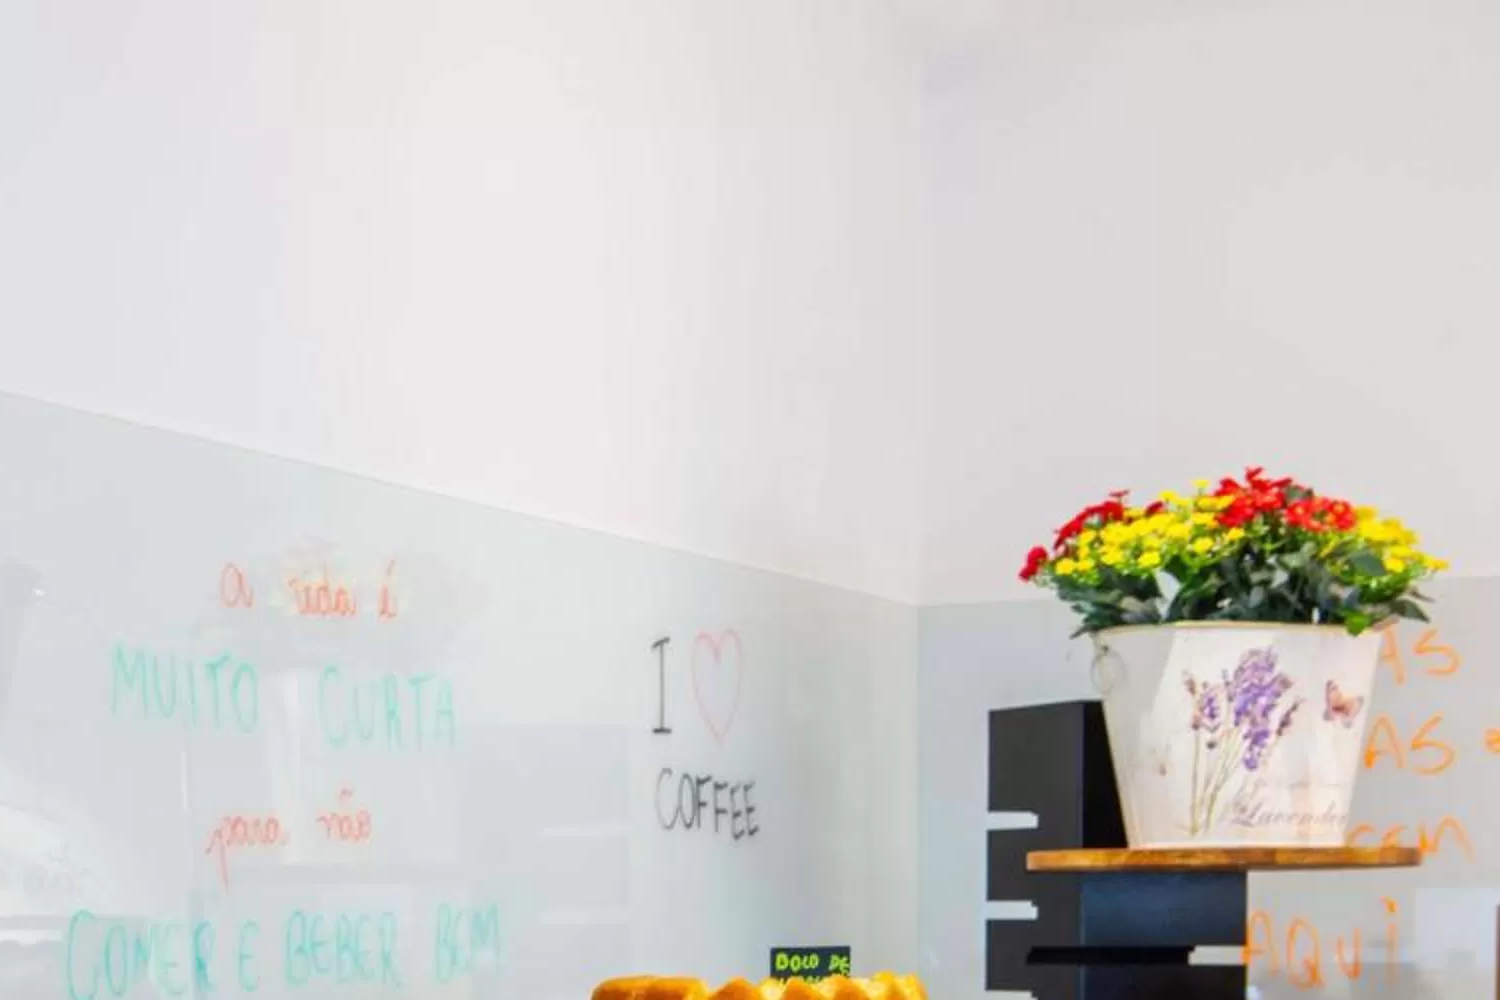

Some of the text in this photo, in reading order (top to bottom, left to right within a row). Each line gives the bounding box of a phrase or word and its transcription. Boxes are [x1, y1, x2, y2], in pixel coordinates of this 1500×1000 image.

[110, 640, 457, 753] MUITO CURTA
[651, 636, 672, 735] I
[654, 767, 760, 842] COFFEE
[204, 814, 291, 893] para
[238, 918, 262, 993] E
[285, 909, 405, 987] BEBER
[433, 902, 504, 985] BEM
[775, 951, 820, 974] BOLO
